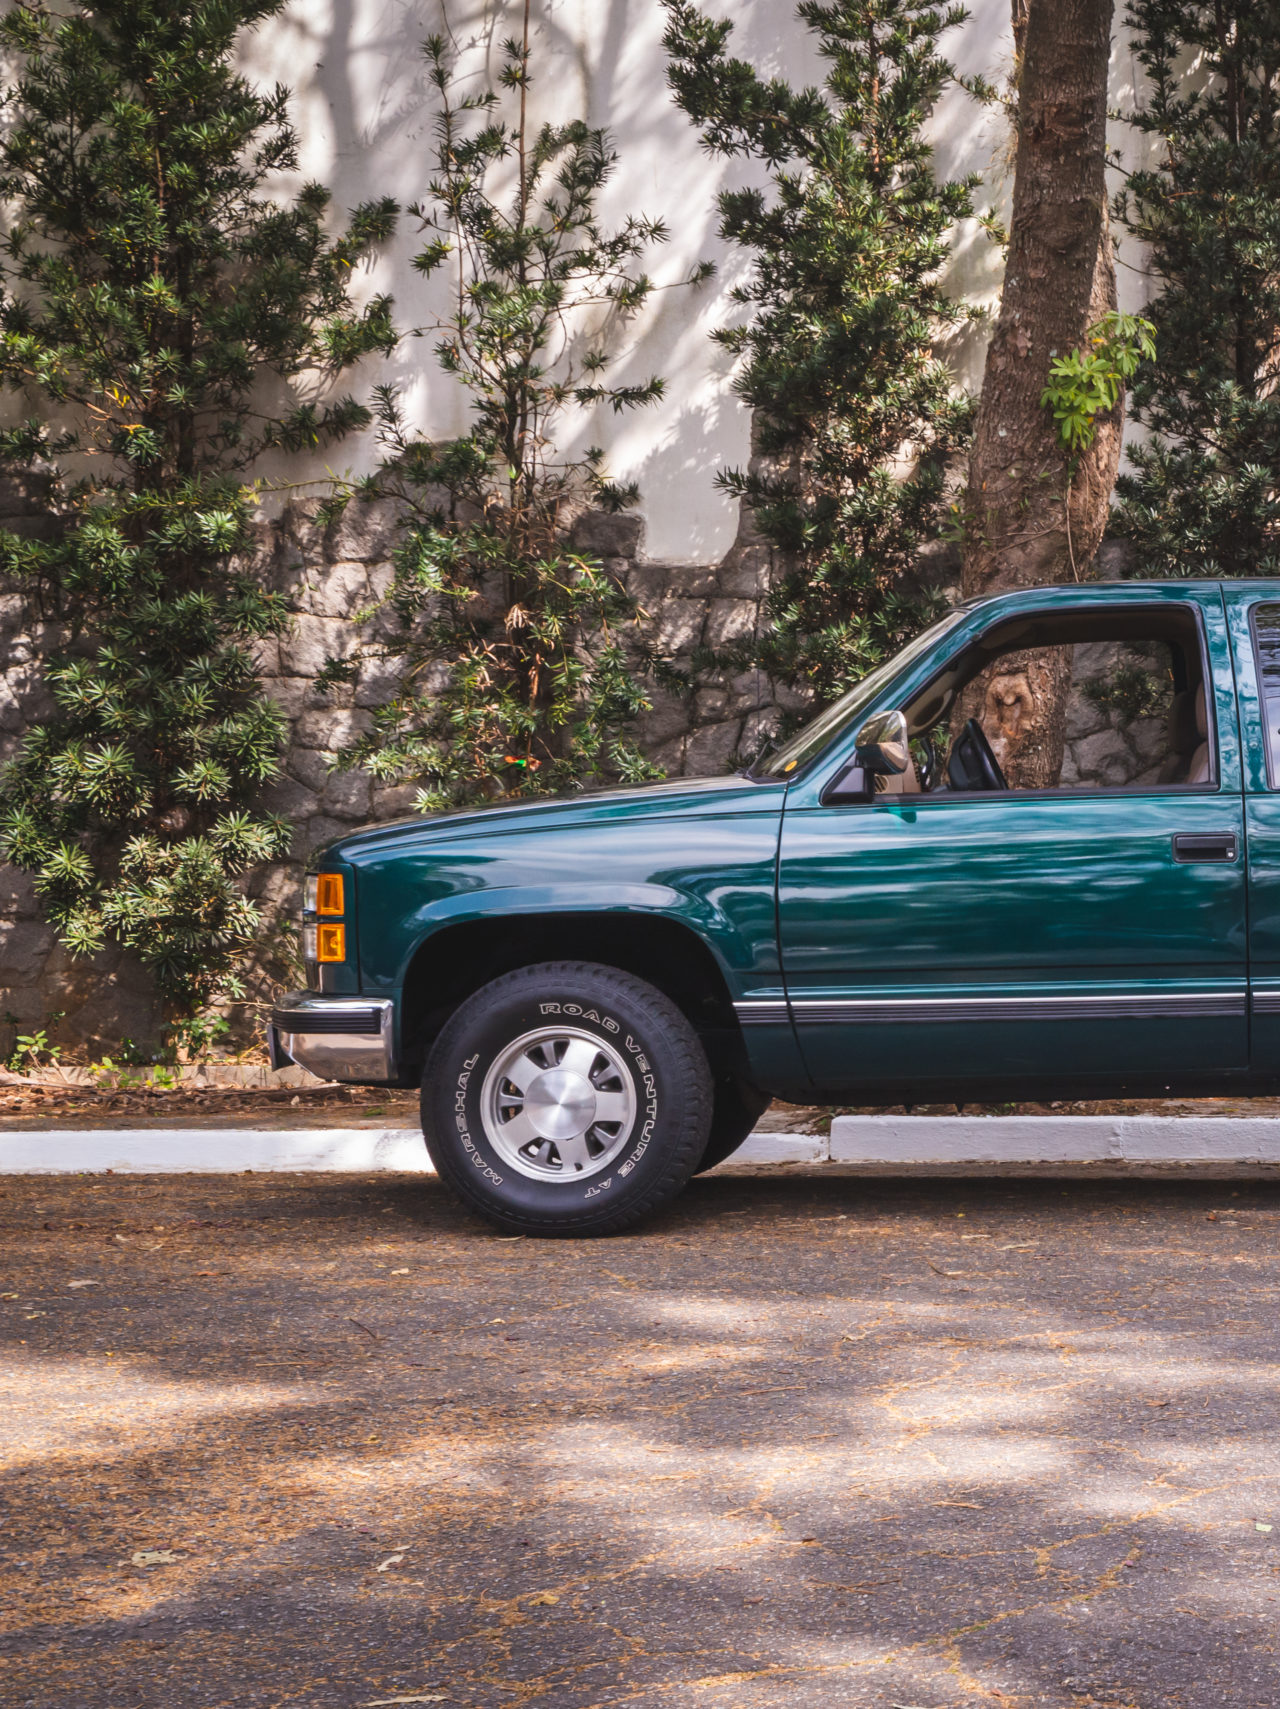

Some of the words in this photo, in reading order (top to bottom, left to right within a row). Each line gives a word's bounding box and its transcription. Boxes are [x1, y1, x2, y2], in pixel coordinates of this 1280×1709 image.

[539, 1002, 619, 1034] ROAD
[455, 1053, 504, 1186] MARSHAL
[618, 1035, 657, 1178] VENTURE
[584, 1177, 612, 1198] AT
